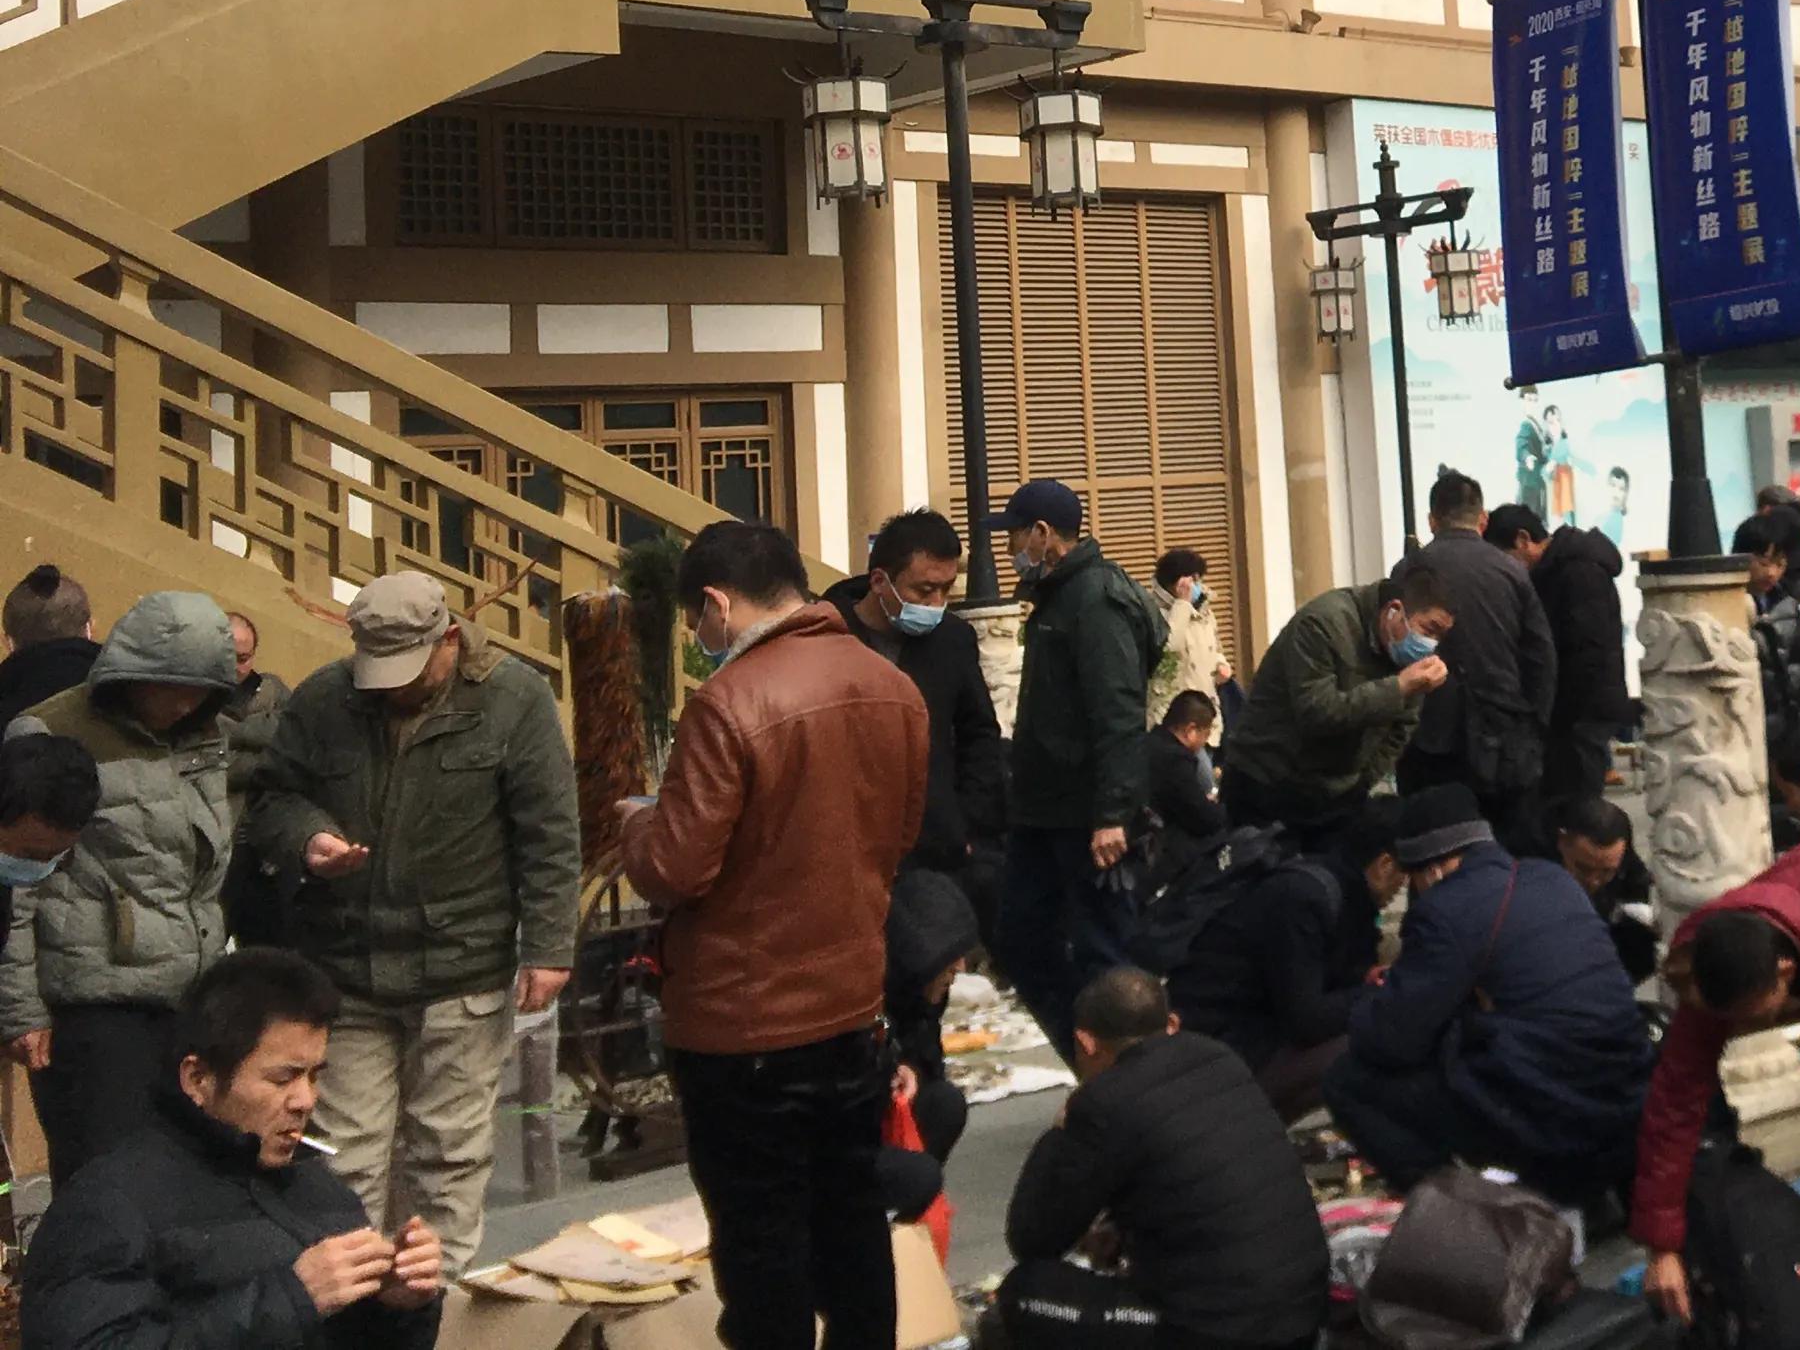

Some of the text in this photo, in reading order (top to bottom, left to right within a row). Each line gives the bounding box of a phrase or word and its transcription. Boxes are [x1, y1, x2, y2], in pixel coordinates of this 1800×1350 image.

[1528, 55, 1555, 275] 千年风物新丝路
[1685, 8, 1720, 241] 千年风物新丝路
